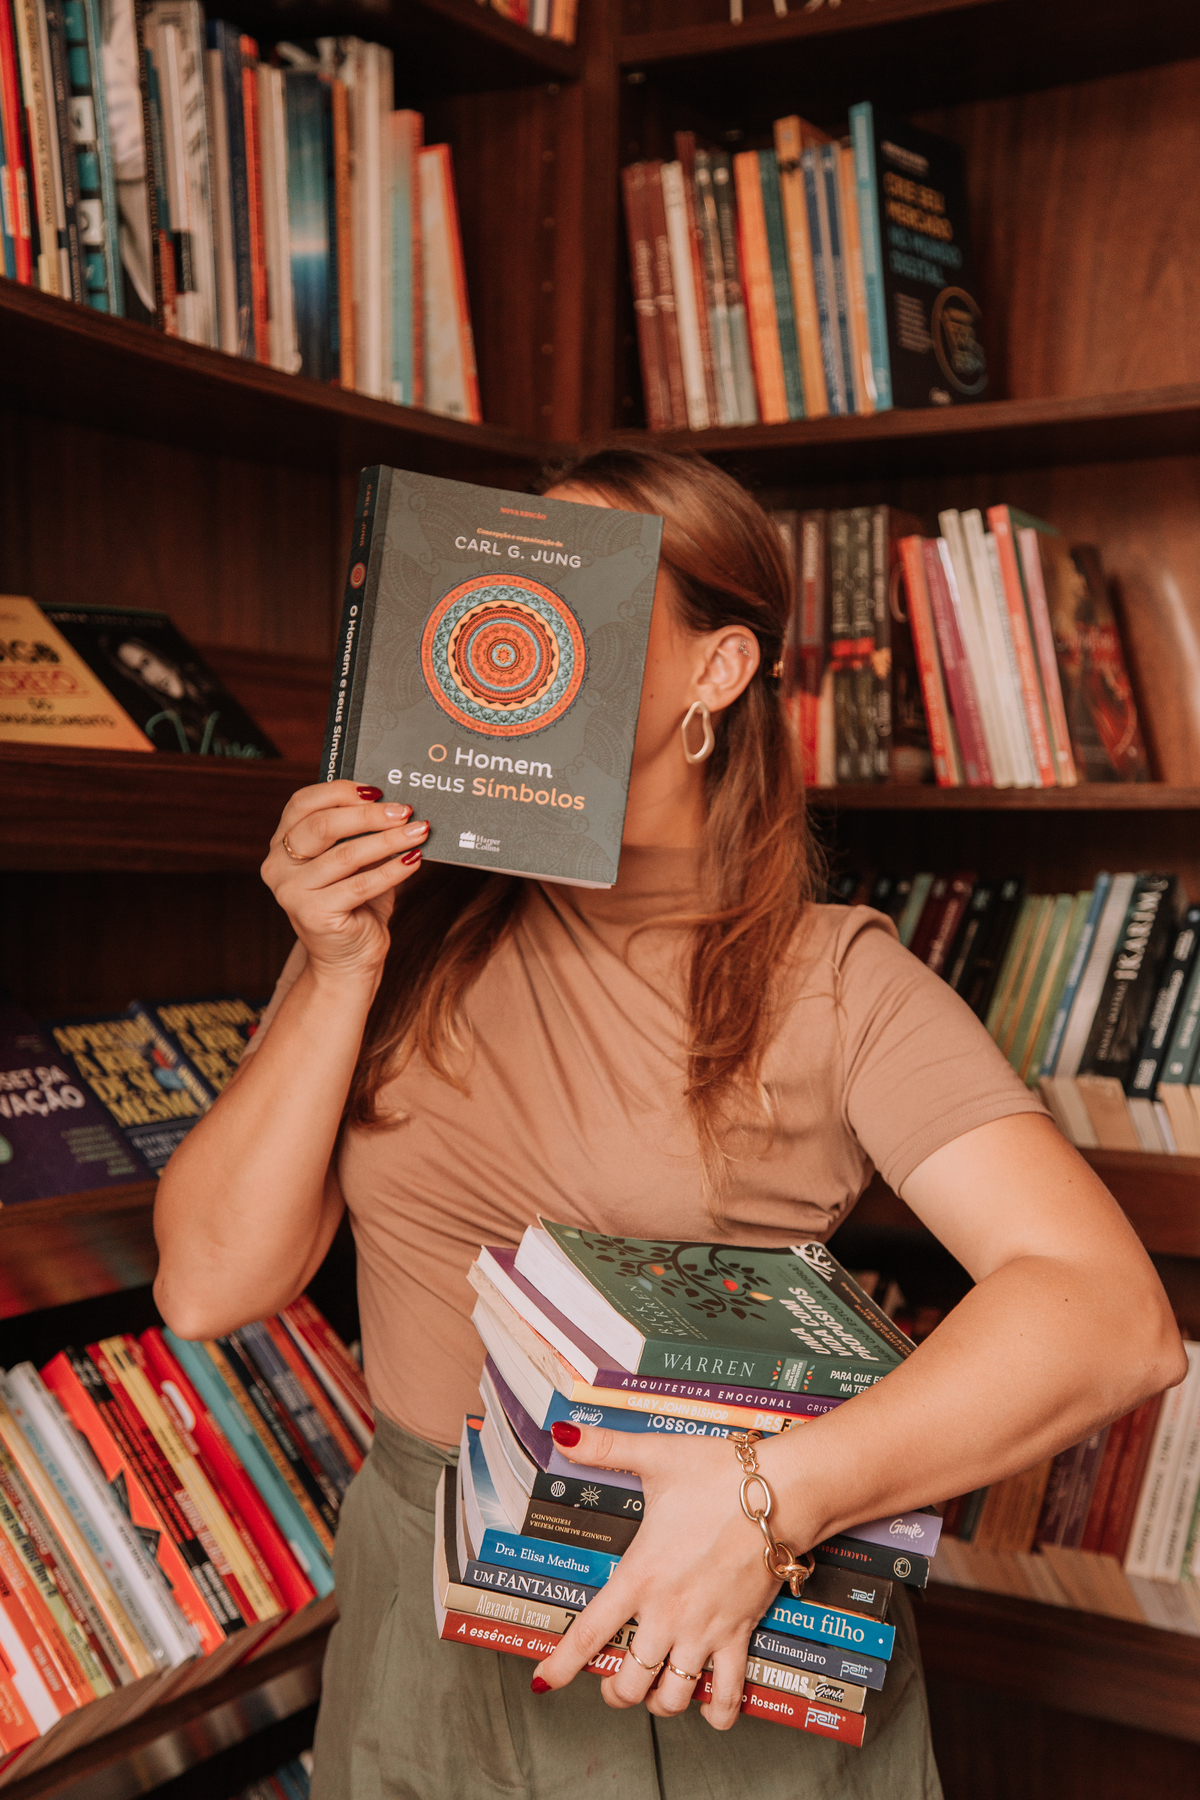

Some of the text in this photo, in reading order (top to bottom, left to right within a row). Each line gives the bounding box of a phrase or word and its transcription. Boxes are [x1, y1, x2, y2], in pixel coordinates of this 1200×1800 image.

[477, 528, 511, 540] Concepção
[454, 535, 582, 568] CARL G. JUNG
[327, 604, 358, 783] O Homem e seus Símbolo
[428, 744, 553, 778] O Homem
[388, 768, 585, 810] e seus Símbolos
[475, 841, 500, 852] Collins
[477, 834, 501, 846] Harper
[624, 1283, 689, 1337] WARREN
[631, 1304, 674, 1336] RICK
[827, 1301, 858, 1328] ESTOU
[778, 1298, 854, 1357] VIDA COM
[787, 1286, 880, 1362] PROPÓSITOS
[853, 1326, 876, 1345] QUE
[790, 1327, 832, 1355] UMA
[664, 1352, 756, 1379] WARREN
[830, 1370, 852, 1381] PARA
[853, 1373, 872, 1384] QUE
[621, 1377, 712, 1399] ARQUITETURA
[718, 1390, 792, 1409] EMOCIONAL
[839, 1383, 853, 1393] NA
[569, 1409, 603, 1427] Gente
[627, 1396, 729, 1421] GARY JOHN BISHOP
[647, 1414, 708, 1435] POSSO!
[529, 1519, 612, 1542] GILVANIZE BALBINO PEREIRA
[531, 1512, 572, 1525] FERDINANDO
[889, 1518, 925, 1539] Gente
[494, 1542, 517, 1558] Dra.
[520, 1547, 545, 1563] Elisa
[547, 1553, 590, 1574] Medhus
[840, 1548, 868, 1562] BLACKIE
[473, 1569, 588, 1606] UM FANTASMA
[476, 1594, 551, 1629] Alexandre Lacava
[773, 1606, 865, 1642] meu filho
[457, 1622, 466, 1635] A
[469, 1627, 524, 1647] essência
[754, 1633, 827, 1666] Kilimanjaro
[762, 1664, 810, 1695] VENDAS
[839, 1660, 869, 1679] petit
[815, 1682, 845, 1700] Gente
[750, 1695, 795, 1716] Rossatto
[804, 1707, 842, 1731] petit
